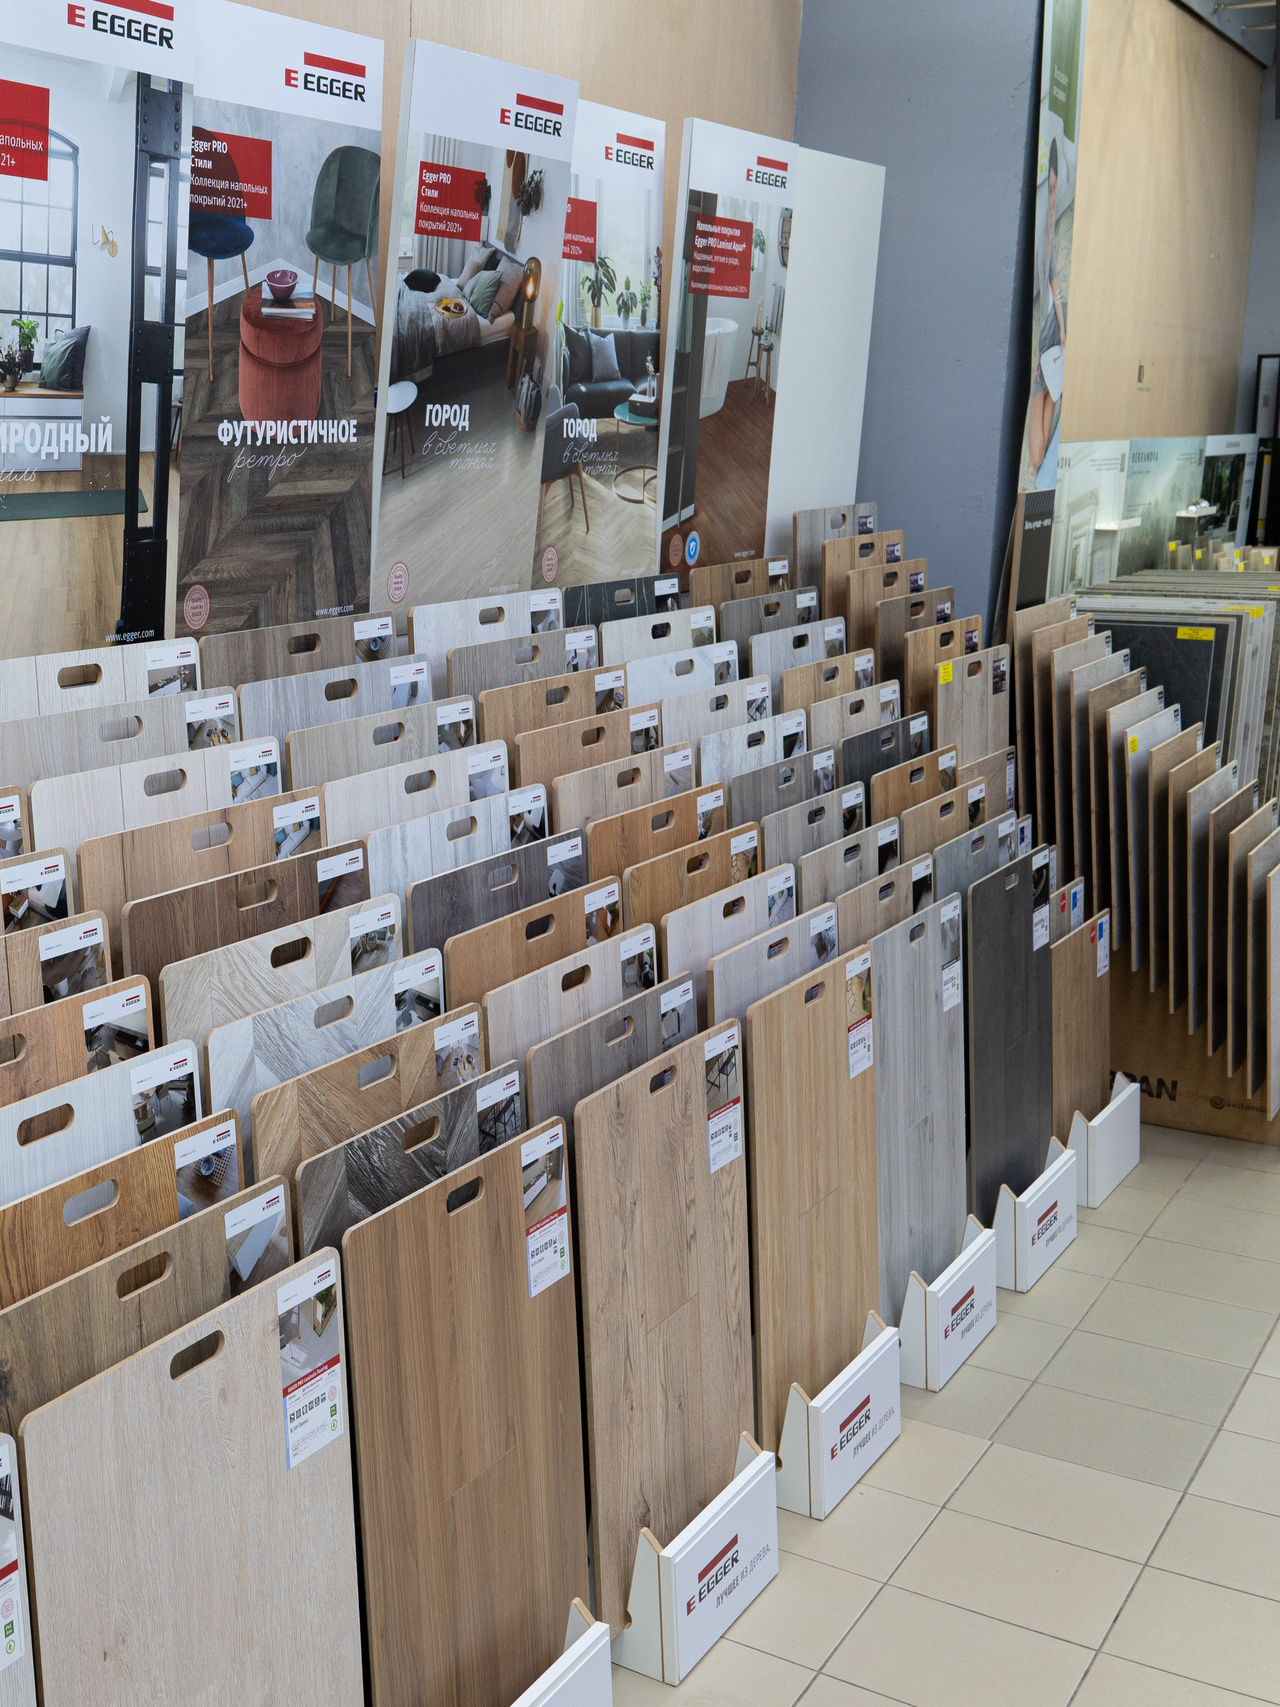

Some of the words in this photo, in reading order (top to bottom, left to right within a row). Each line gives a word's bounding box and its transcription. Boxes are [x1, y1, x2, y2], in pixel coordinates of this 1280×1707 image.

[92, 9, 174, 50] EGGER
[303, 72, 366, 102] EGGER
[514, 111, 563, 138] EGGER
[212, 140, 228, 154] PRO
[191, 155, 213, 170] Стили
[615, 149, 655, 171] EGGER
[230, 181, 268, 195] напольных
[422, 169, 440, 184] Egger
[440, 172, 452, 184] PRO
[755, 170, 788, 189] EGGER
[189, 193, 226, 207] покрытий
[227, 196, 248, 209] 2021+
[421, 186, 439, 198] Стили
[419, 202, 450, 218] Коллекция
[450, 208, 479, 221] напольных
[418, 219, 447, 231] покрытий
[447, 222, 463, 233] 2021+
[425, 403, 470, 432] ГОРОД
[217, 419, 358, 447] ФУТУРИСТИЧНОЕ
[563, 418, 597, 442] ГОРОД
[422, 431, 438, 456] в
[434, 431, 496, 456] светлых
[572, 442, 620, 463] светлых
[227, 446, 308, 483] ретро
[449, 456, 495, 470] тонах
[105, 629, 155, 643] www.egger.com
[1037, 1211, 1058, 1241] EGGER
[951, 1298, 975, 1333] EGGER
[839, 1408, 871, 1451] EGGER
[698, 1549, 739, 1604] EGGER
[716, 1575, 739, 1609] ЛУЧШЕЕ
[740, 1566, 748, 1581] ИЗ
